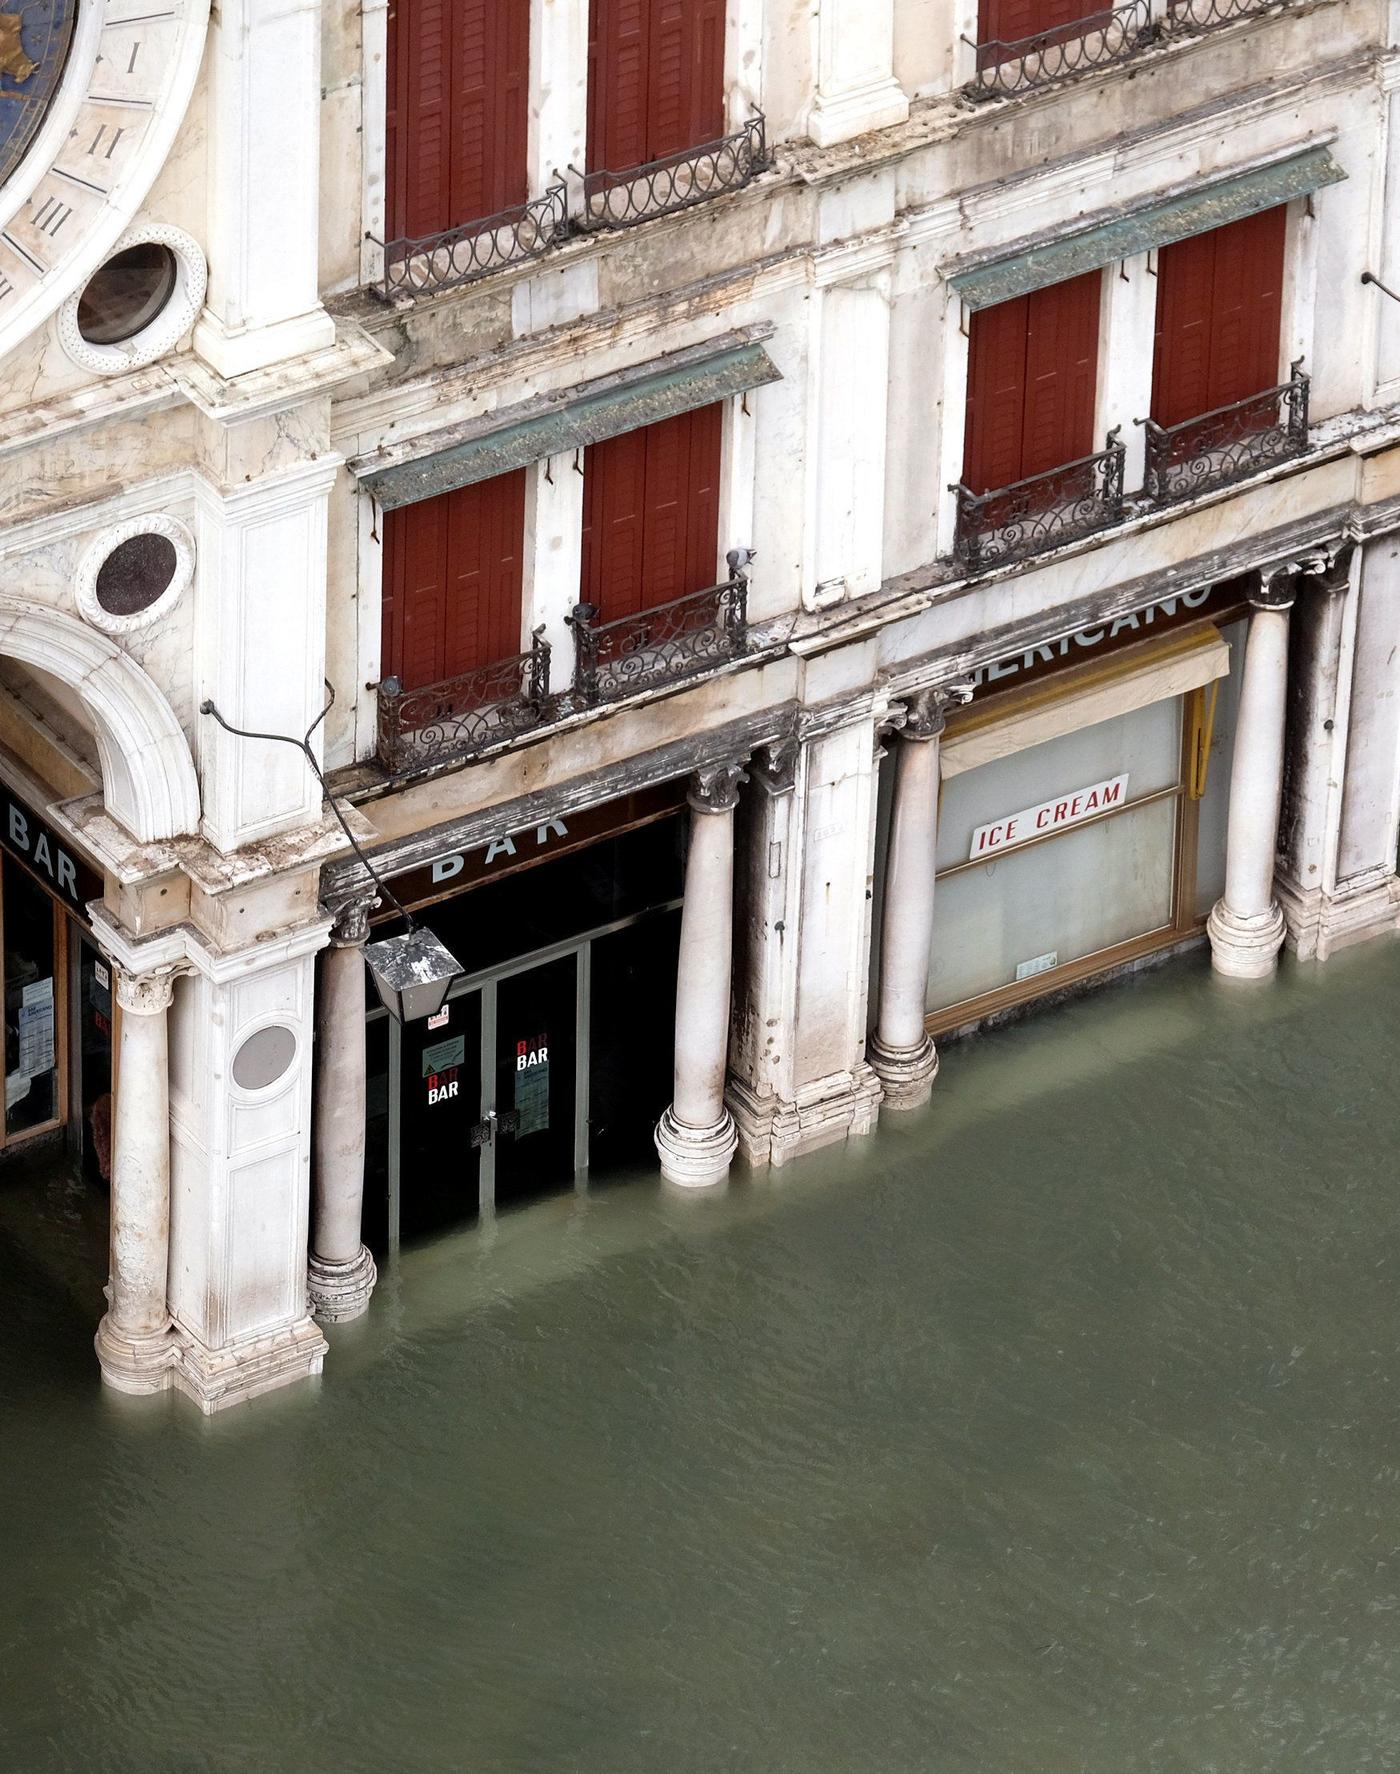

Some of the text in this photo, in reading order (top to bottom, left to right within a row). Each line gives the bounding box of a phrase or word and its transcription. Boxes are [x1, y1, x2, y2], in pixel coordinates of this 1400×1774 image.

[979, 782, 1121, 850] ICE CREAM
[9, 803, 78, 901] BAR
[517, 1047, 548, 1071] BAR
[428, 1081, 458, 1105] BAR
